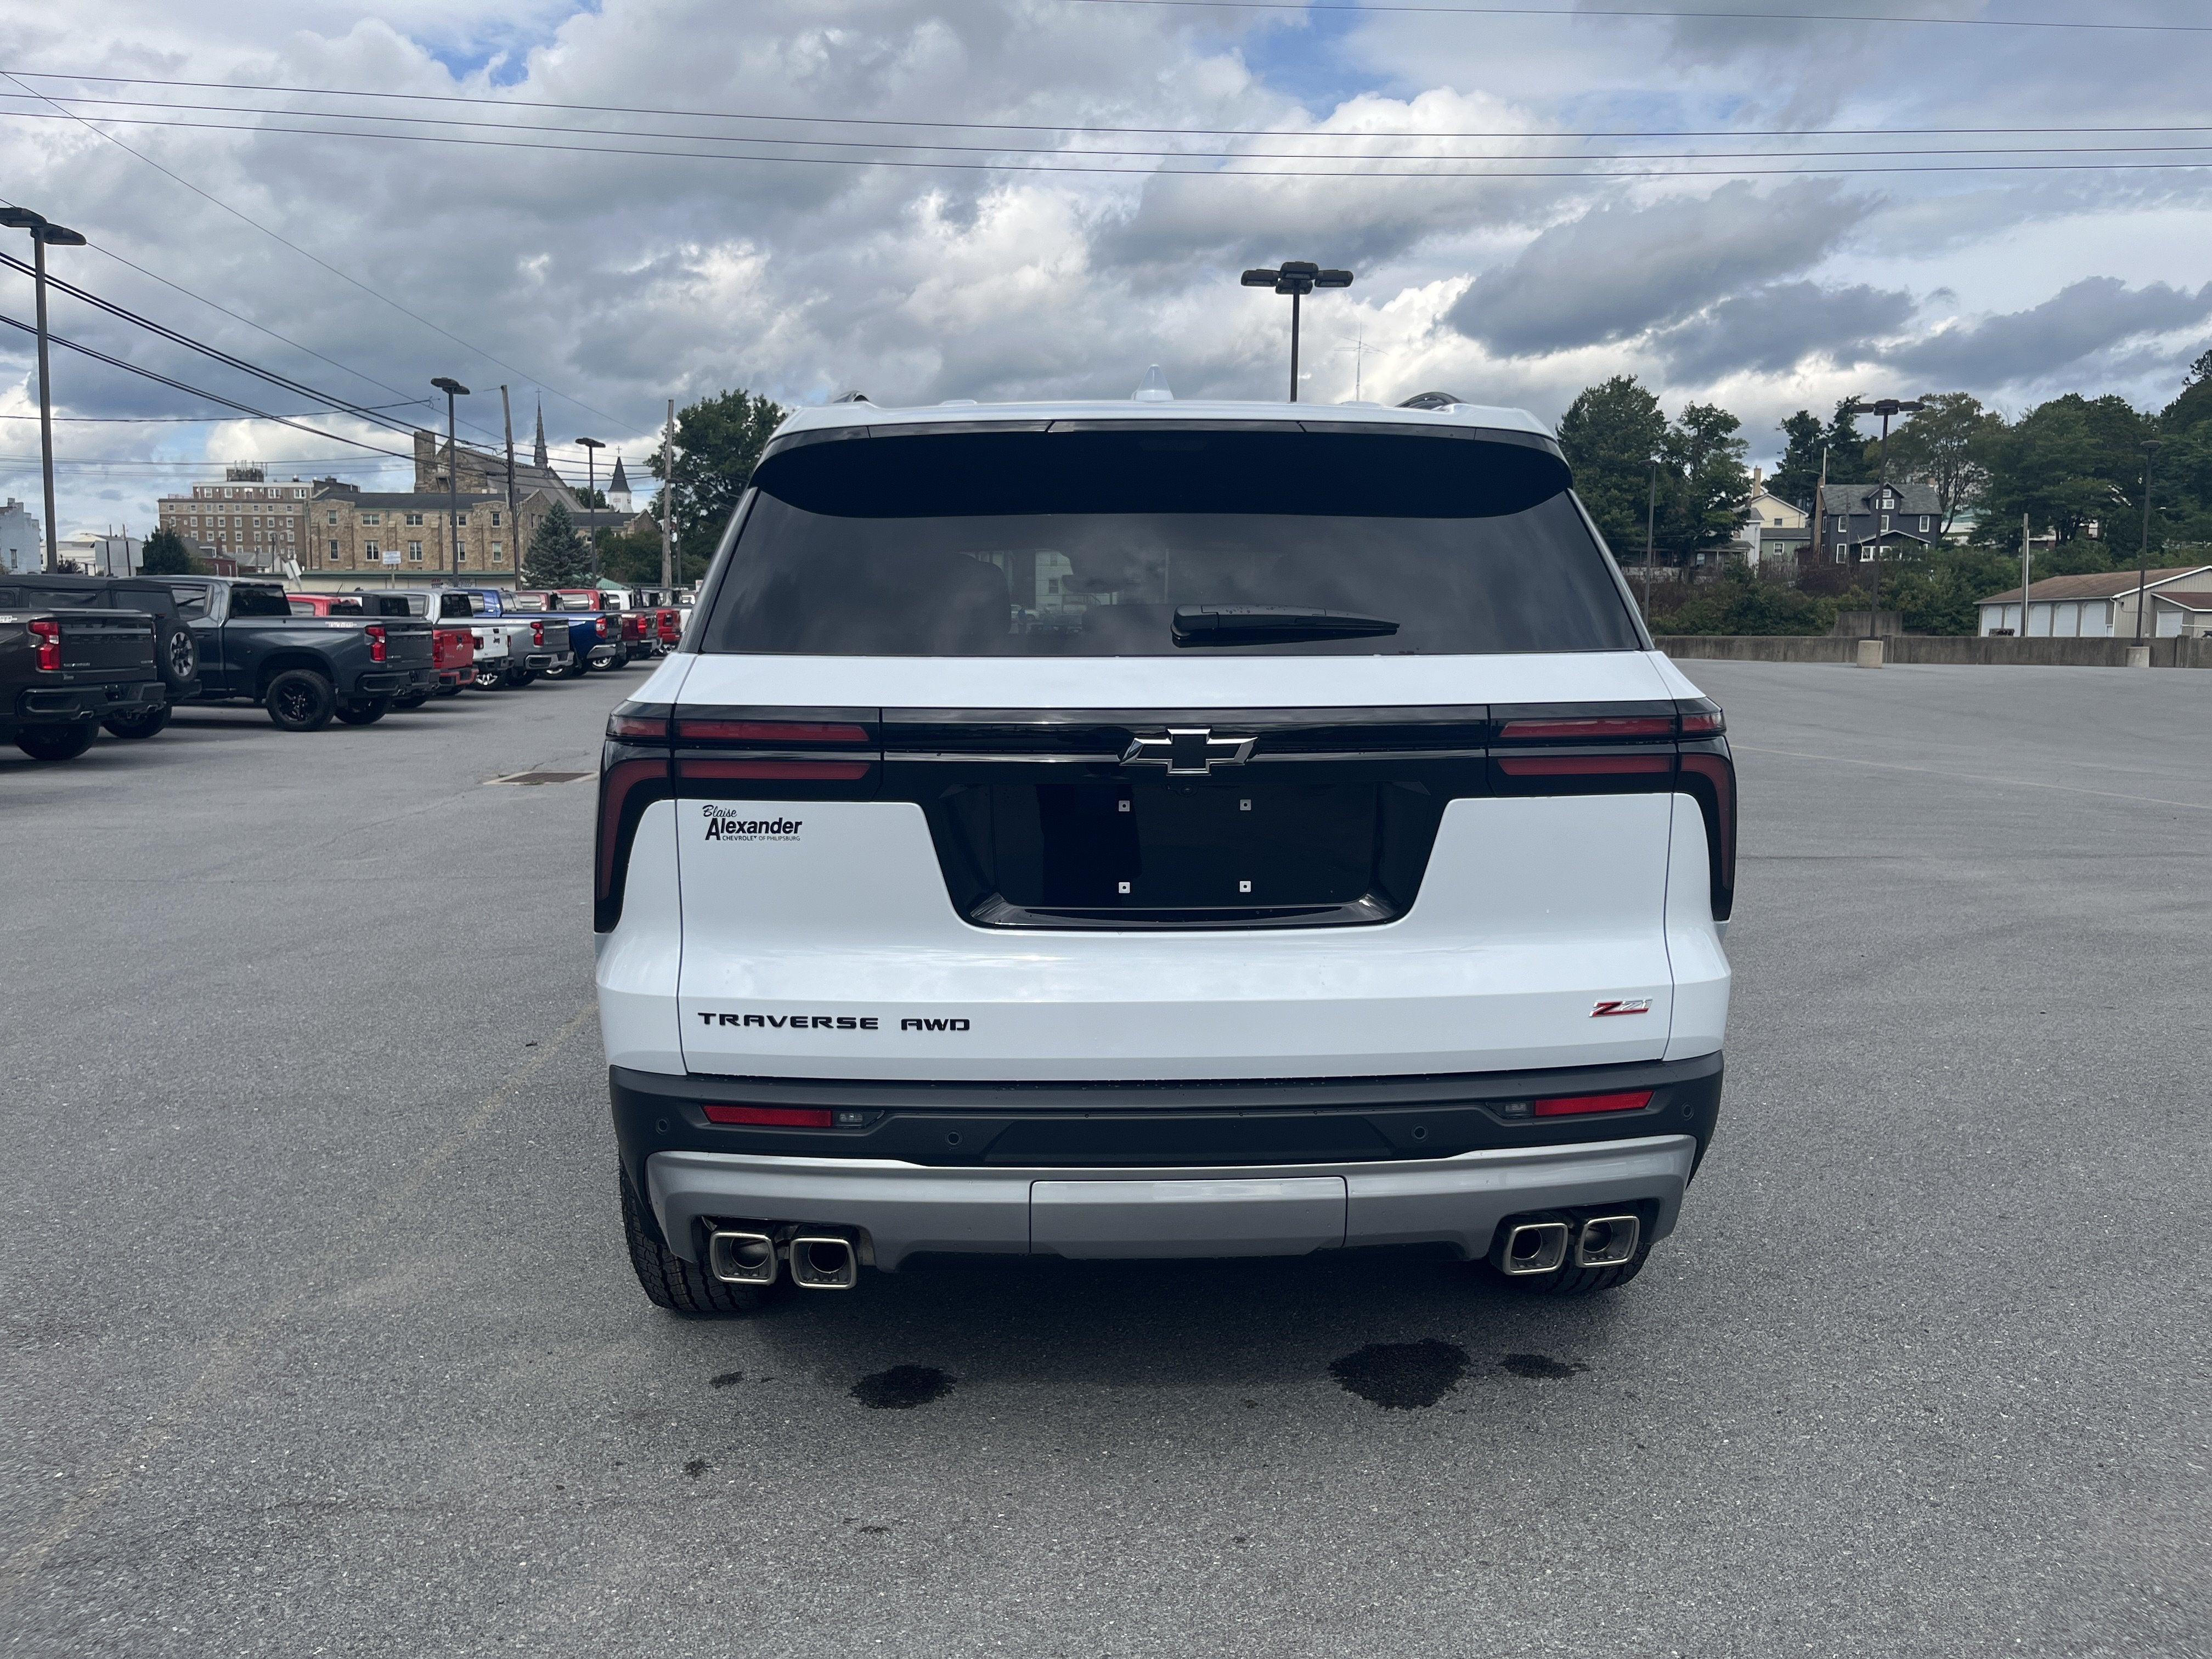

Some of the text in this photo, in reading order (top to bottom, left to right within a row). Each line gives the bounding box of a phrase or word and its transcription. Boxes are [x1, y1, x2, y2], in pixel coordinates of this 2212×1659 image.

[702, 804, 737, 817] Blaise
[705, 817, 803, 840] Alexander
[1589, 999, 1652, 1017] Z71
[698, 1012, 970, 1031] TRAVERSE AWD
